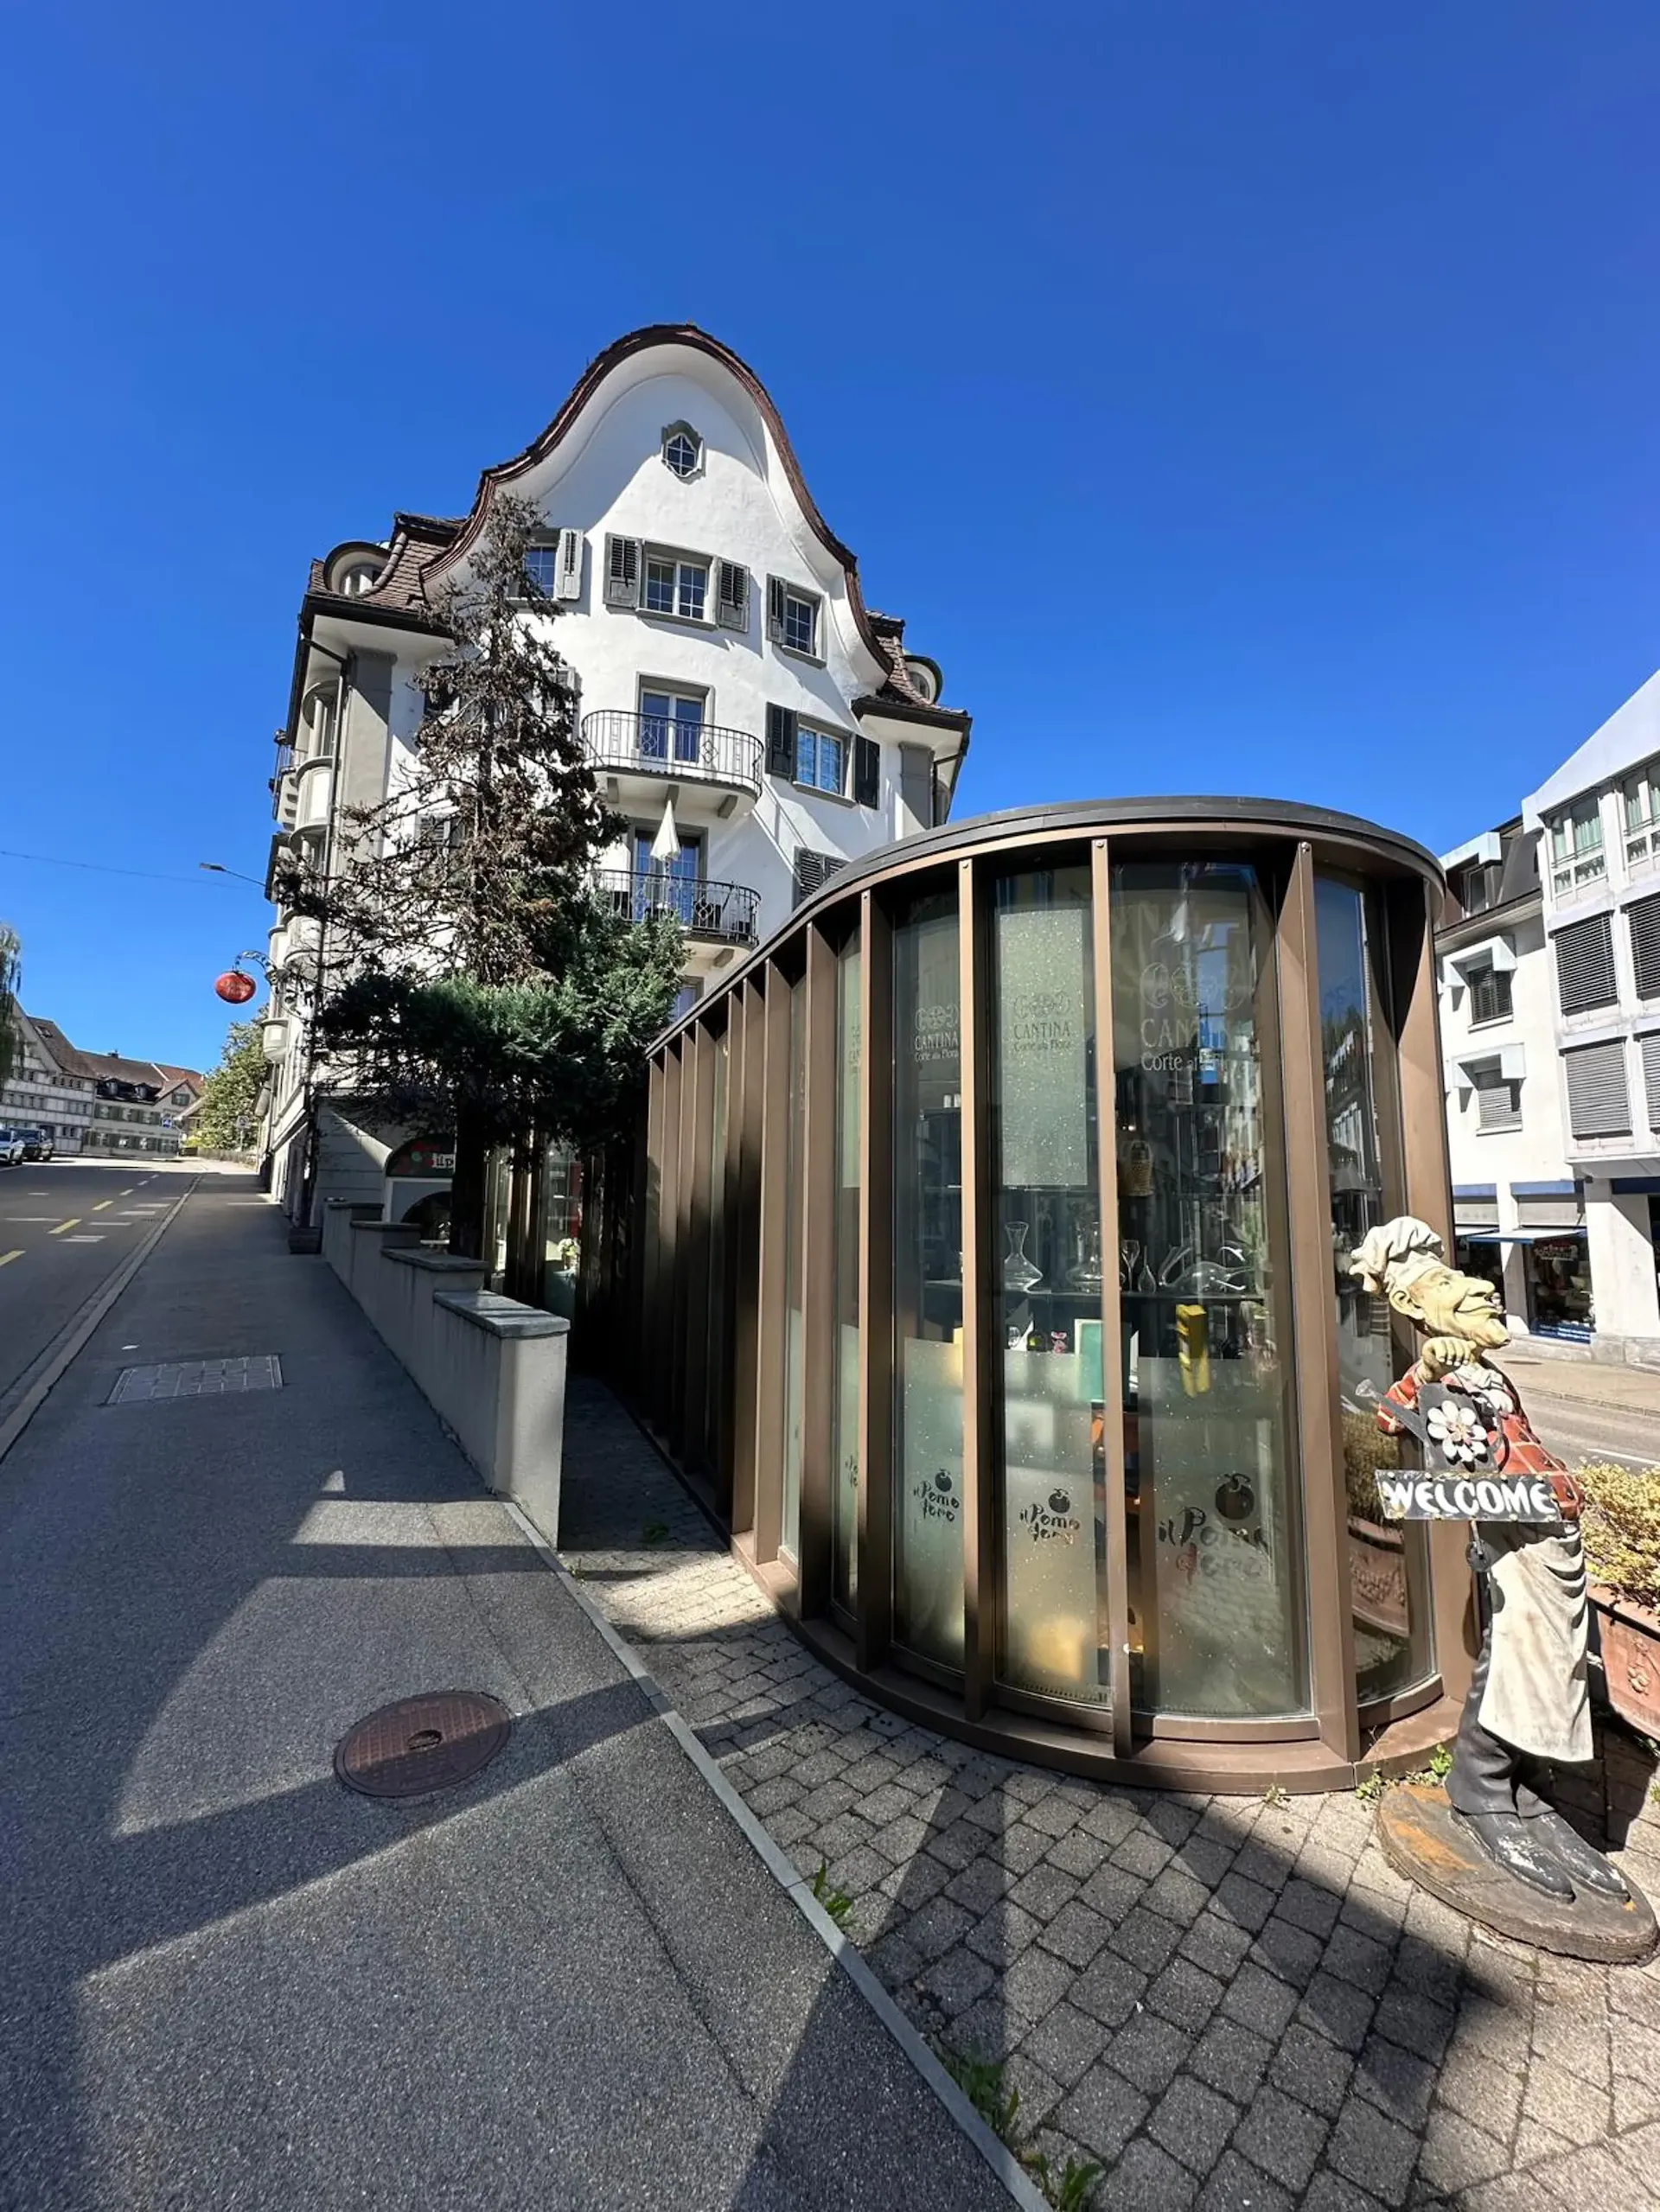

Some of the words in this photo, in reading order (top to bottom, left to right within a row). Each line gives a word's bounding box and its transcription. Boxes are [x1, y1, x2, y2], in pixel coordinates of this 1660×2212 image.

[914, 1030, 959, 1051] CANTINA
[1013, 1020, 1070, 1041] CANTINA
[1140, 1051, 1184, 1071] Corte
[920, 1480, 960, 1508] Pomo
[1382, 1480, 1556, 1515] WELCOME
[1018, 1508, 1028, 1523] il
[1029, 1503, 1080, 1530] Pomo
[1158, 1520, 1176, 1546] il
